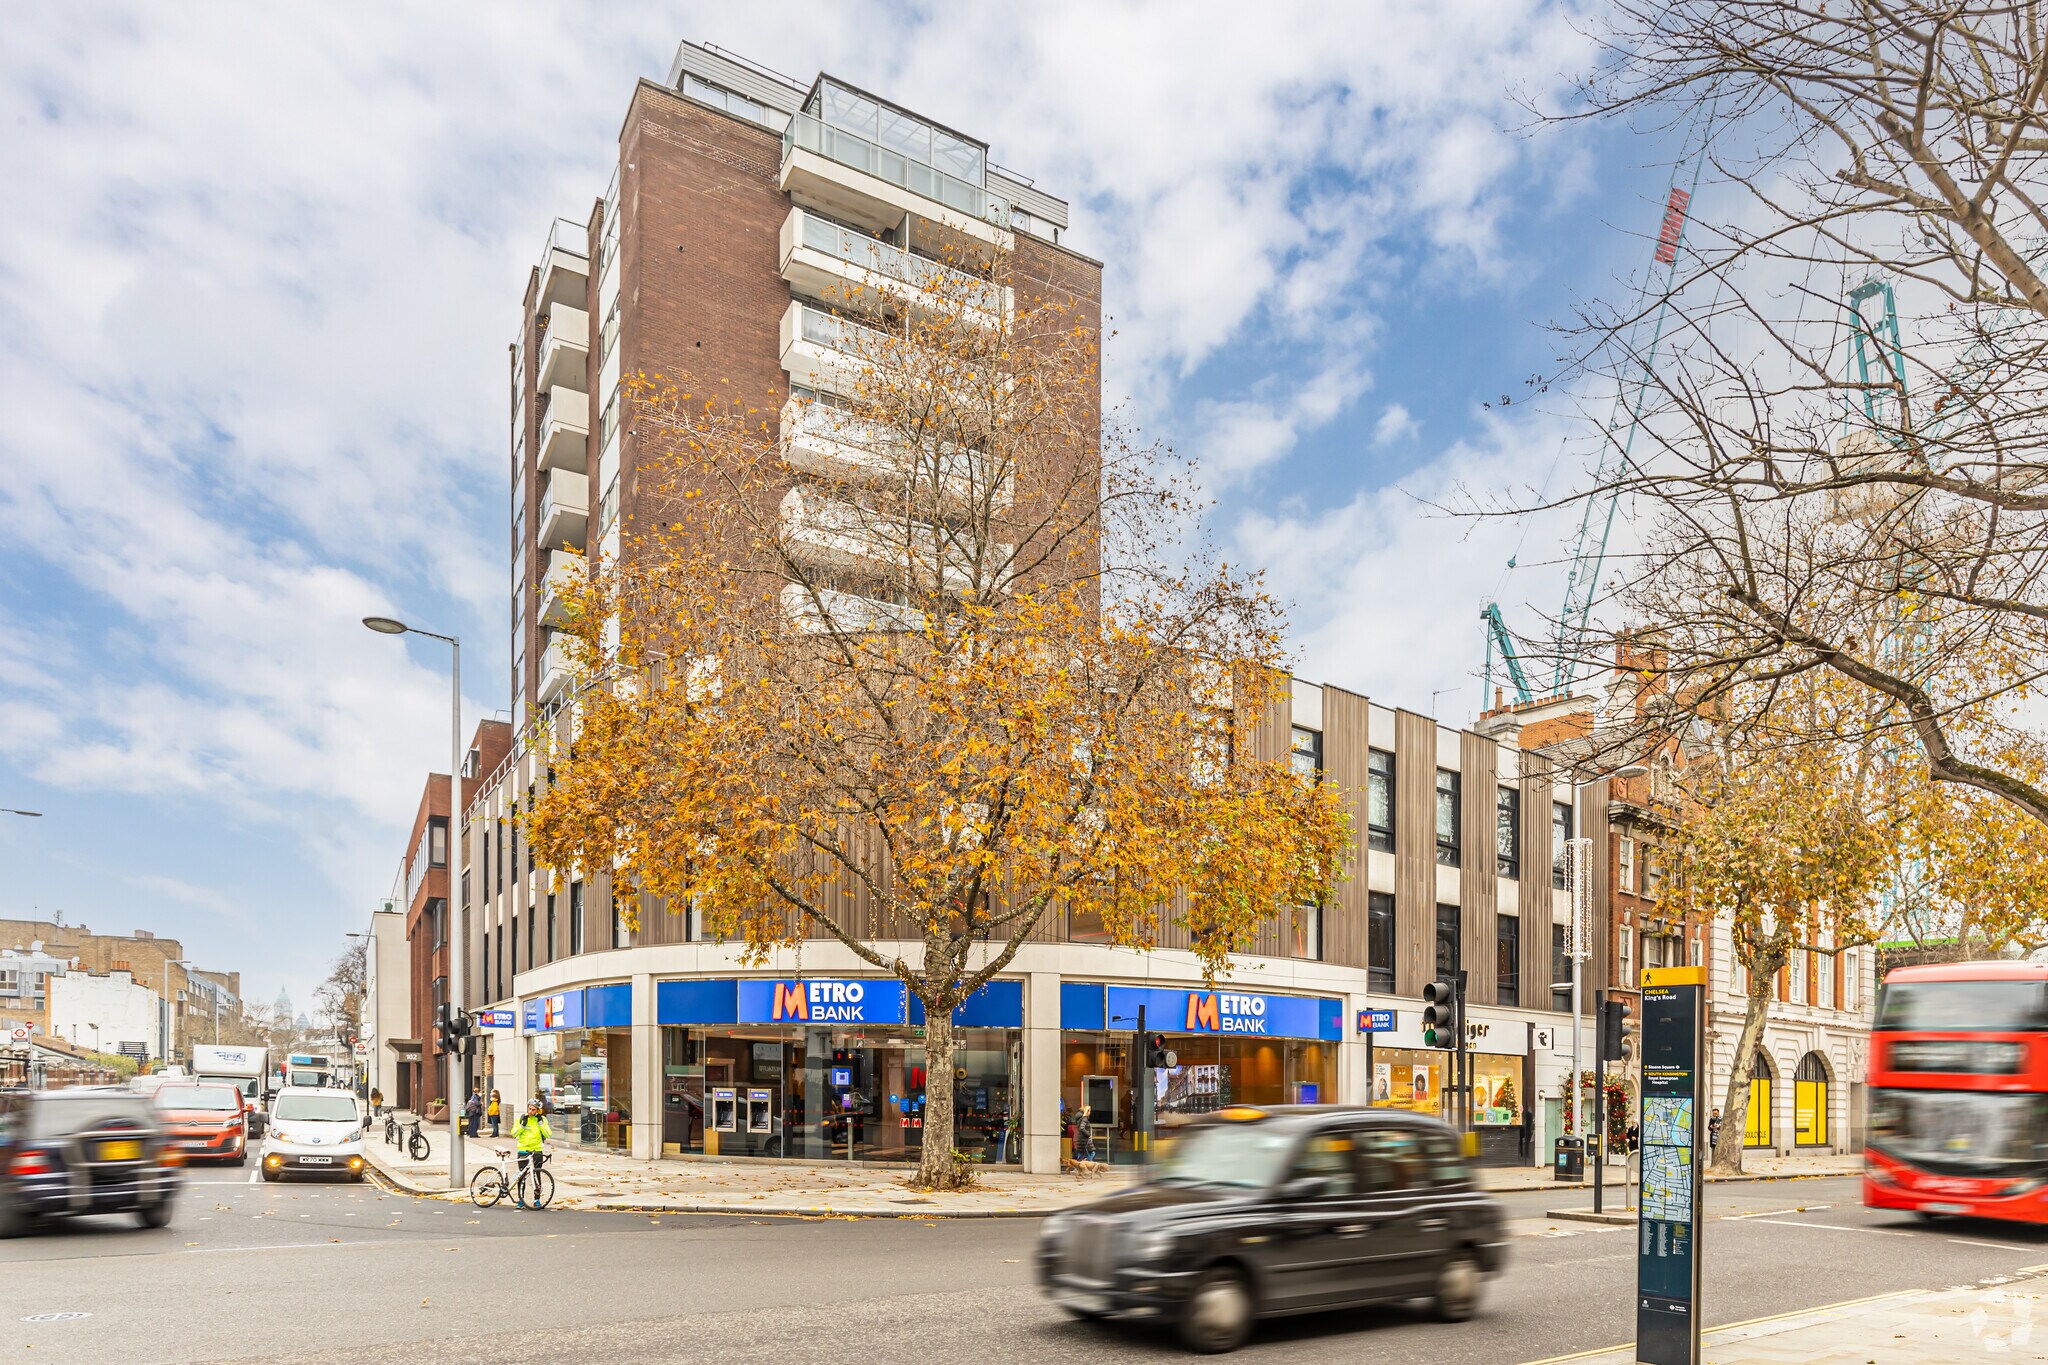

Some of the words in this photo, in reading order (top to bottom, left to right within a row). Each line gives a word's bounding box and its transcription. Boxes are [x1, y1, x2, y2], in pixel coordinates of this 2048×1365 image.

[772, 982, 864, 1020] METRO
[482, 1013, 512, 1024] METRO
[812, 1006, 864, 1020] BANK
[1186, 993, 1266, 1030] METRO
[1222, 1018, 1266, 1033] BANK
[1359, 1013, 1390, 1028] METRO
[1466, 1019, 1489, 1040] iger
